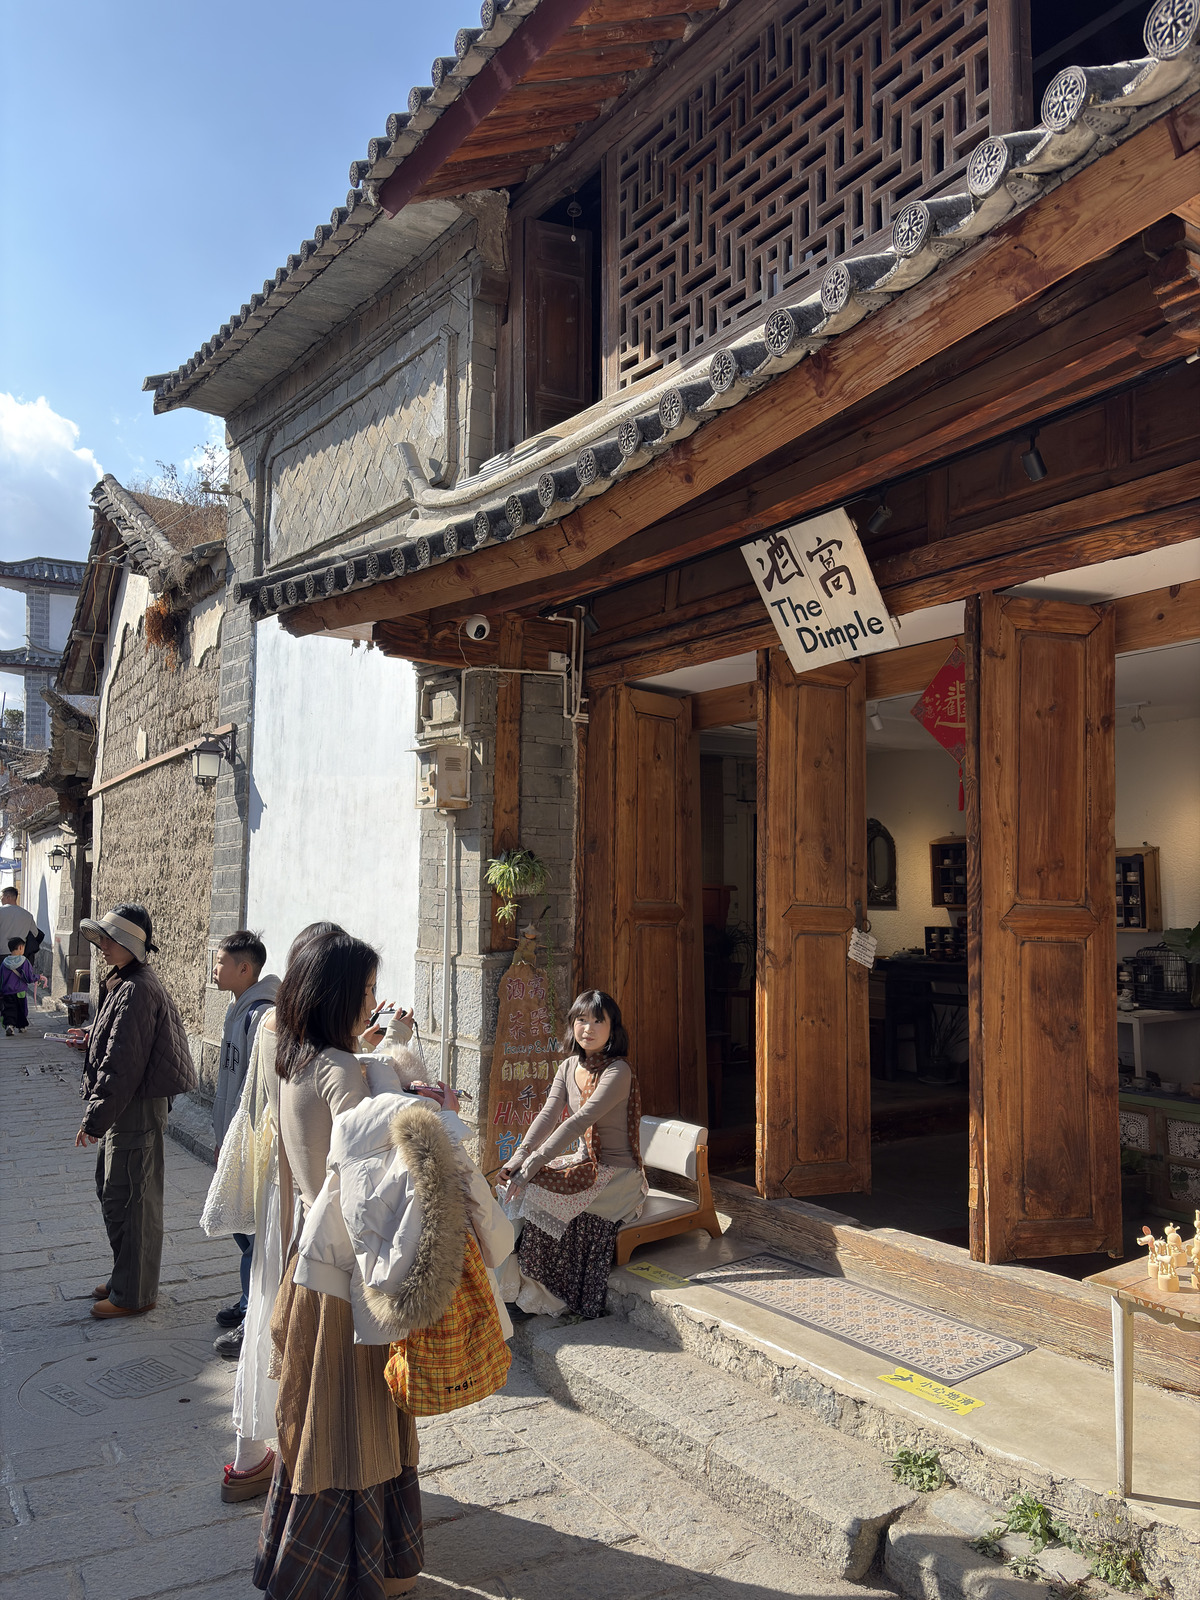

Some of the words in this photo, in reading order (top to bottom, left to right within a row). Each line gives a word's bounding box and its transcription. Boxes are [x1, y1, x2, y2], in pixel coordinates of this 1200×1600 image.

[770, 596, 823, 628] The
[796, 610, 885, 654] Dimple
[919, 1381, 975, 1406] 小心地滑
